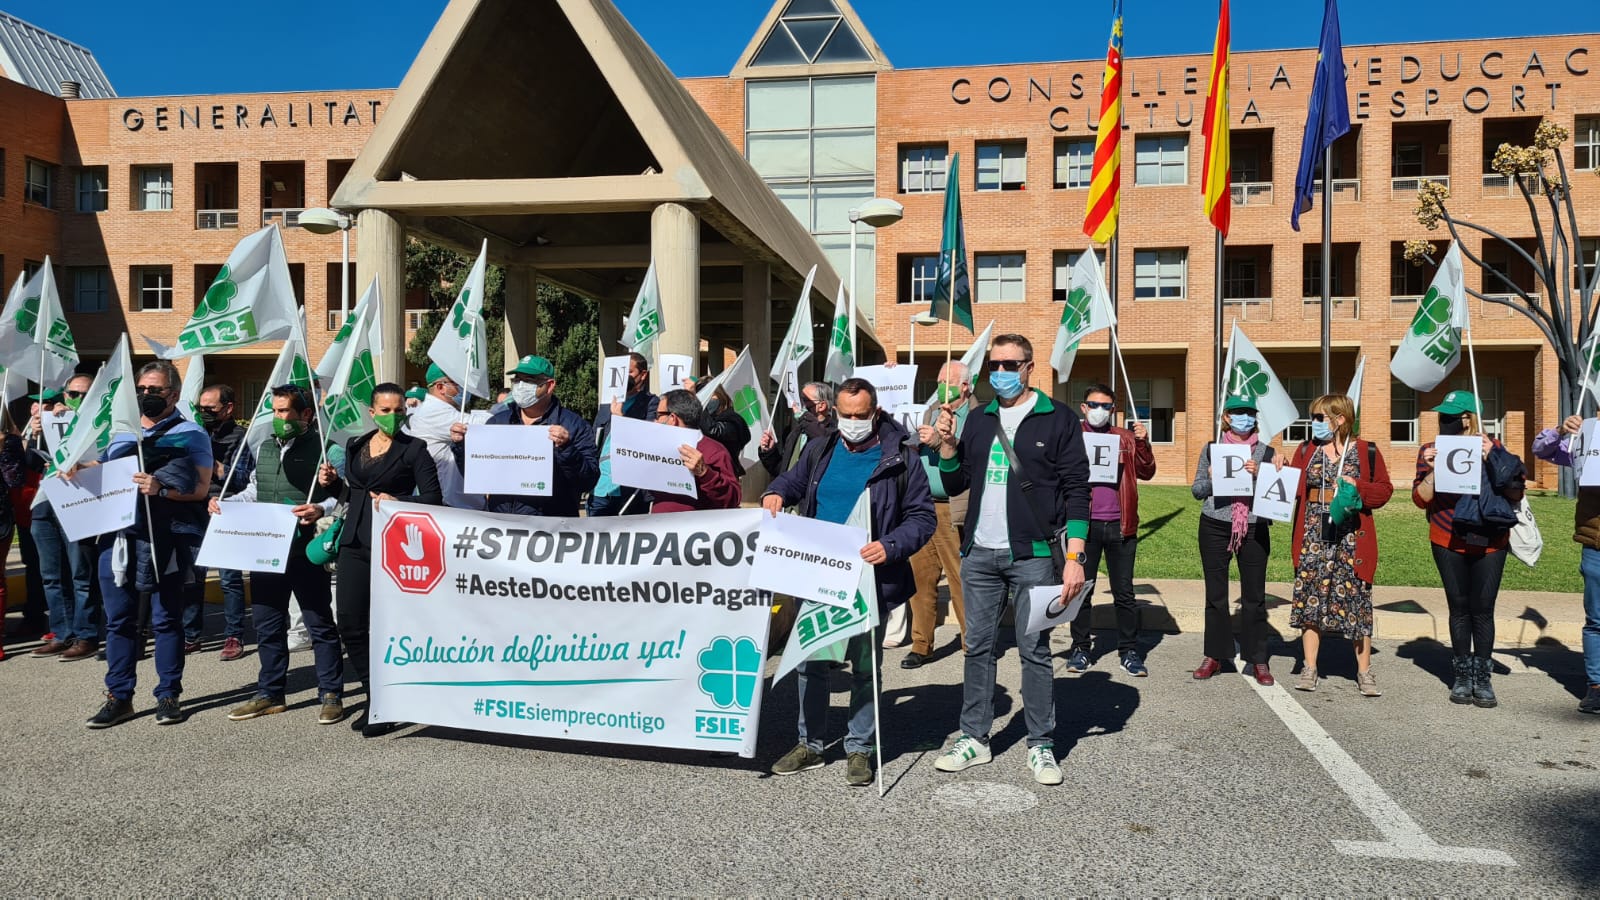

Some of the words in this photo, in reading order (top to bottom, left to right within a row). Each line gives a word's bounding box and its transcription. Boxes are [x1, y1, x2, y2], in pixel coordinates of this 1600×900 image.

[951, 64, 1291, 105] CONSLLEIA
[1343, 47, 1589, 86] 'EDUCAC
[123, 100, 381, 132] GENERALITAT
[1050, 98, 1263, 132] CULTUA
[1356, 83, 1561, 118] ESPORT
[608, 366, 627, 388] N
[667, 364, 684, 386] T
[901, 411, 920, 433] N
[1091, 445, 1111, 466] E
[1221, 455, 1245, 478] P
[1446, 448, 1475, 475] G
[1260, 477, 1291, 504] A
[763, 545, 853, 571] #STOPIMPAGOS
[399, 563, 430, 582] STOP
[384, 635, 494, 666] ¡Solución
[502, 633, 629, 671] definitiva
[637, 630, 687, 668] ya!
[473, 698, 665, 734] #FSIEsiemprecontigo
